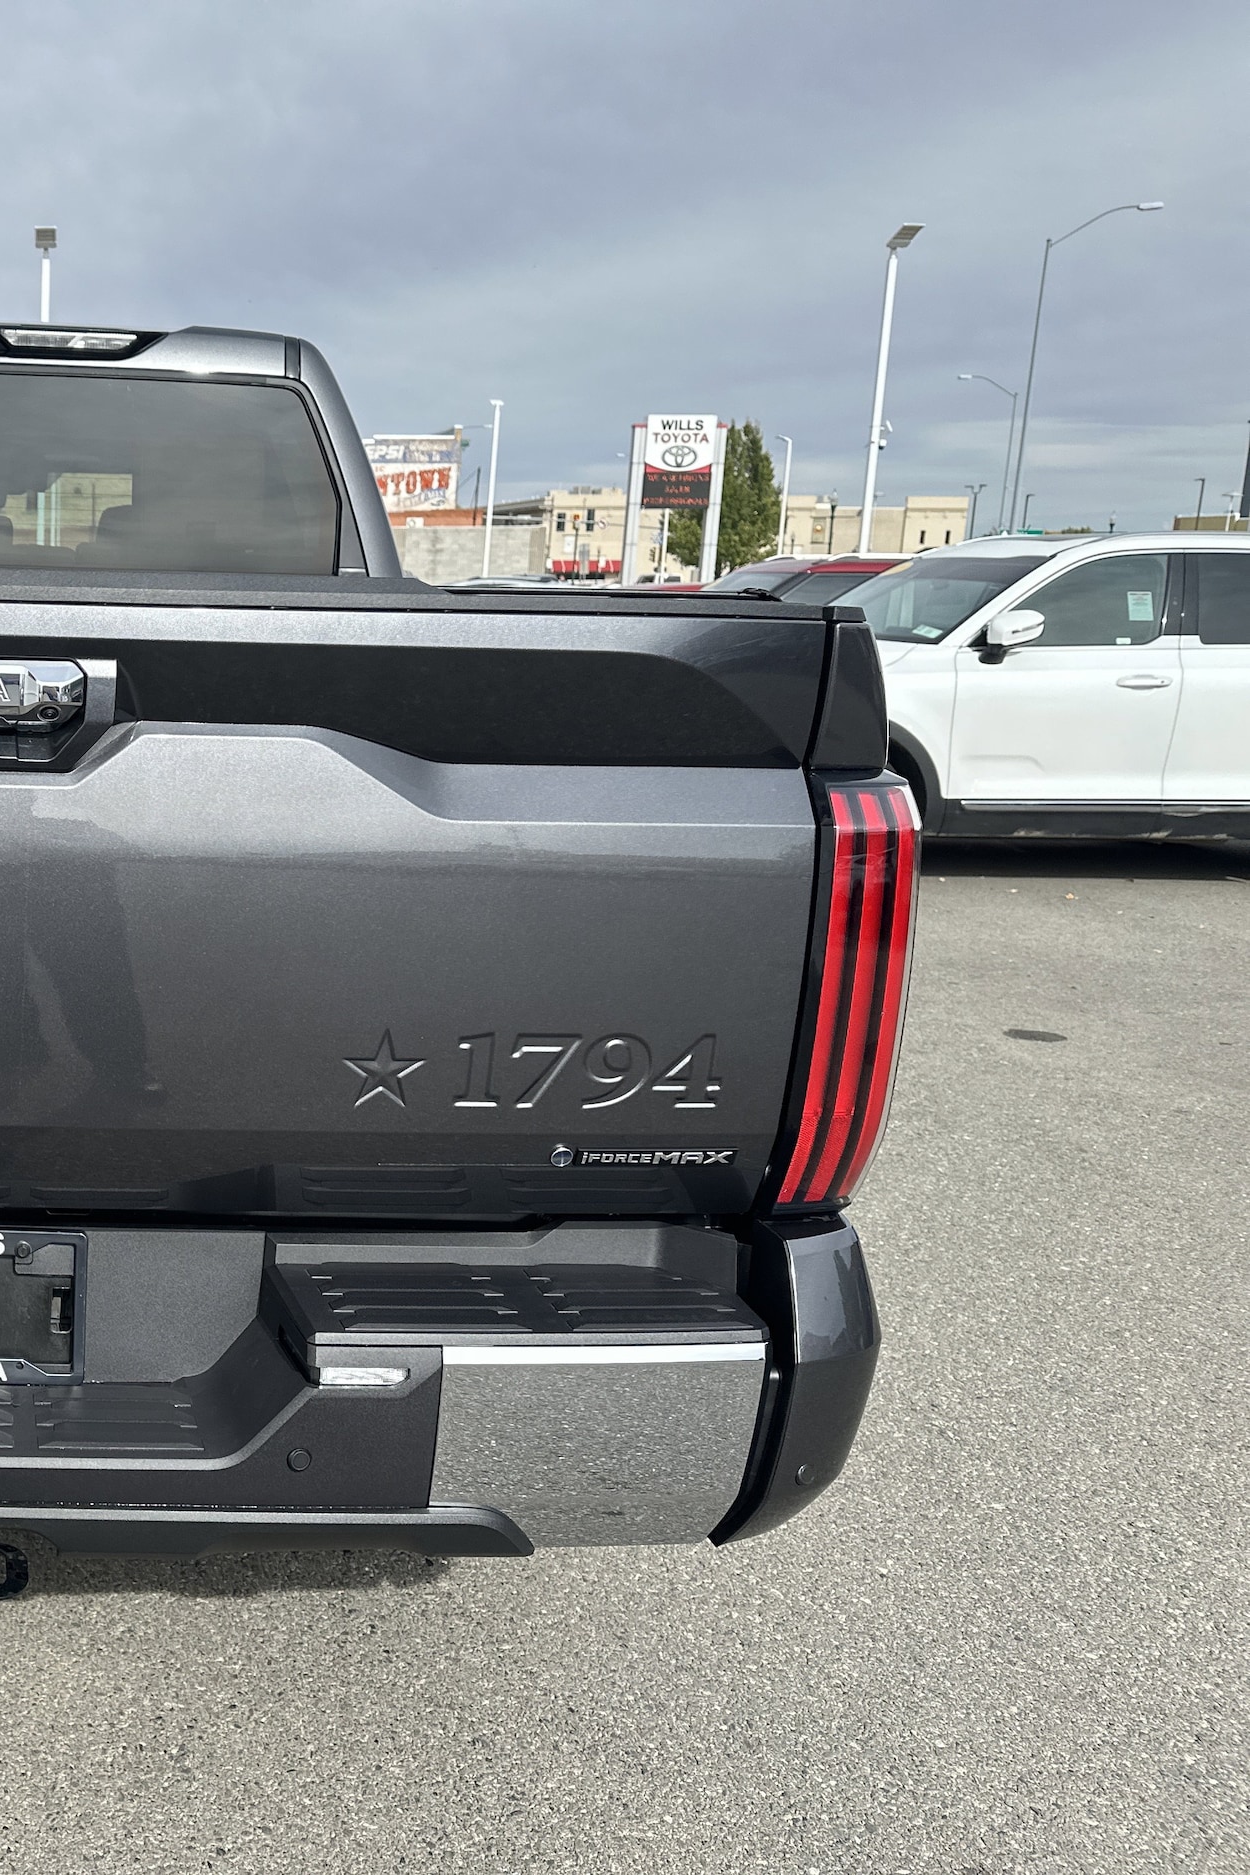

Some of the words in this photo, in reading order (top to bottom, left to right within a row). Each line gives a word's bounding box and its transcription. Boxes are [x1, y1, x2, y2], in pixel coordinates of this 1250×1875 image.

[661, 419, 704, 431] WILLS
[653, 432, 709, 444] TOYOTA
[365, 445, 405, 460] EPSI
[377, 467, 452, 497] NTOWN
[452, 1031, 724, 1110] 1794
